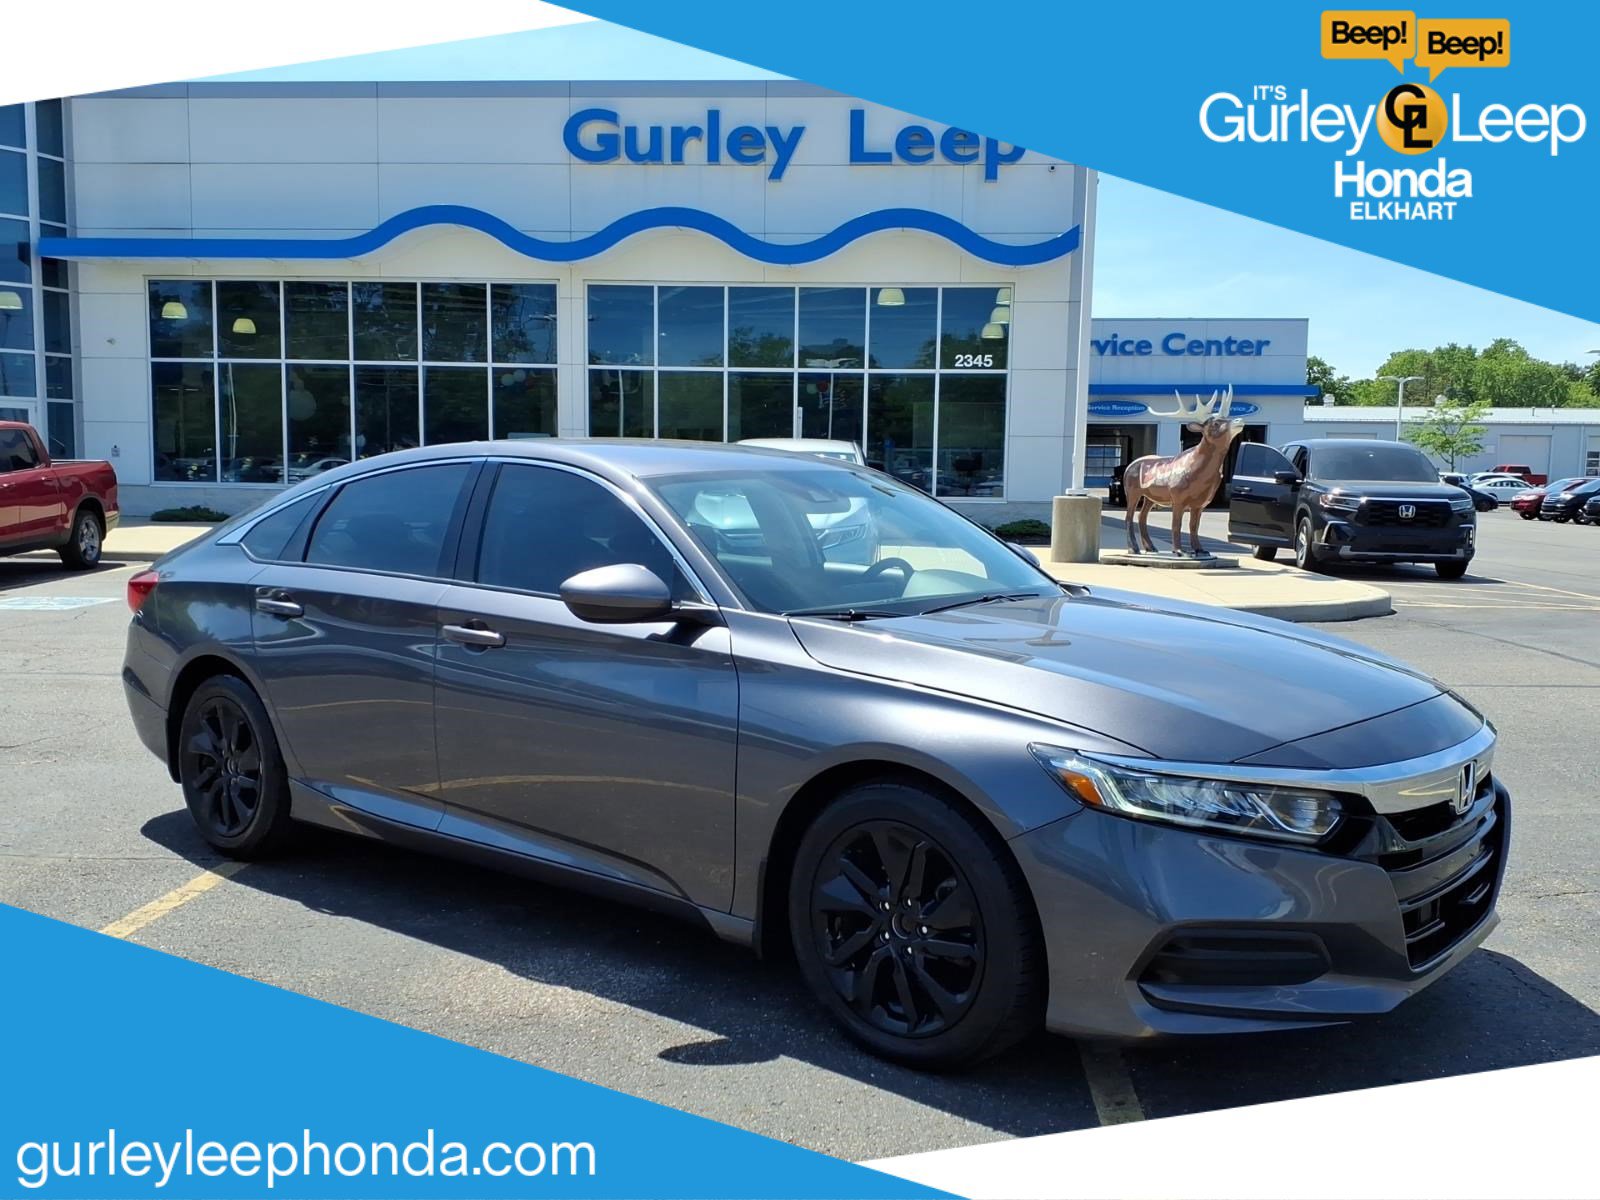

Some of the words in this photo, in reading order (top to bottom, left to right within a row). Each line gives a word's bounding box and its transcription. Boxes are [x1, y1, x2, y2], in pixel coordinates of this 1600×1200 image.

[562, 108, 805, 182] Gurley
[849, 109, 1027, 183] Leep
[1090, 333, 1153, 356] vice
[1161, 332, 1271, 356] Center
[954, 354, 993, 367] 2345
